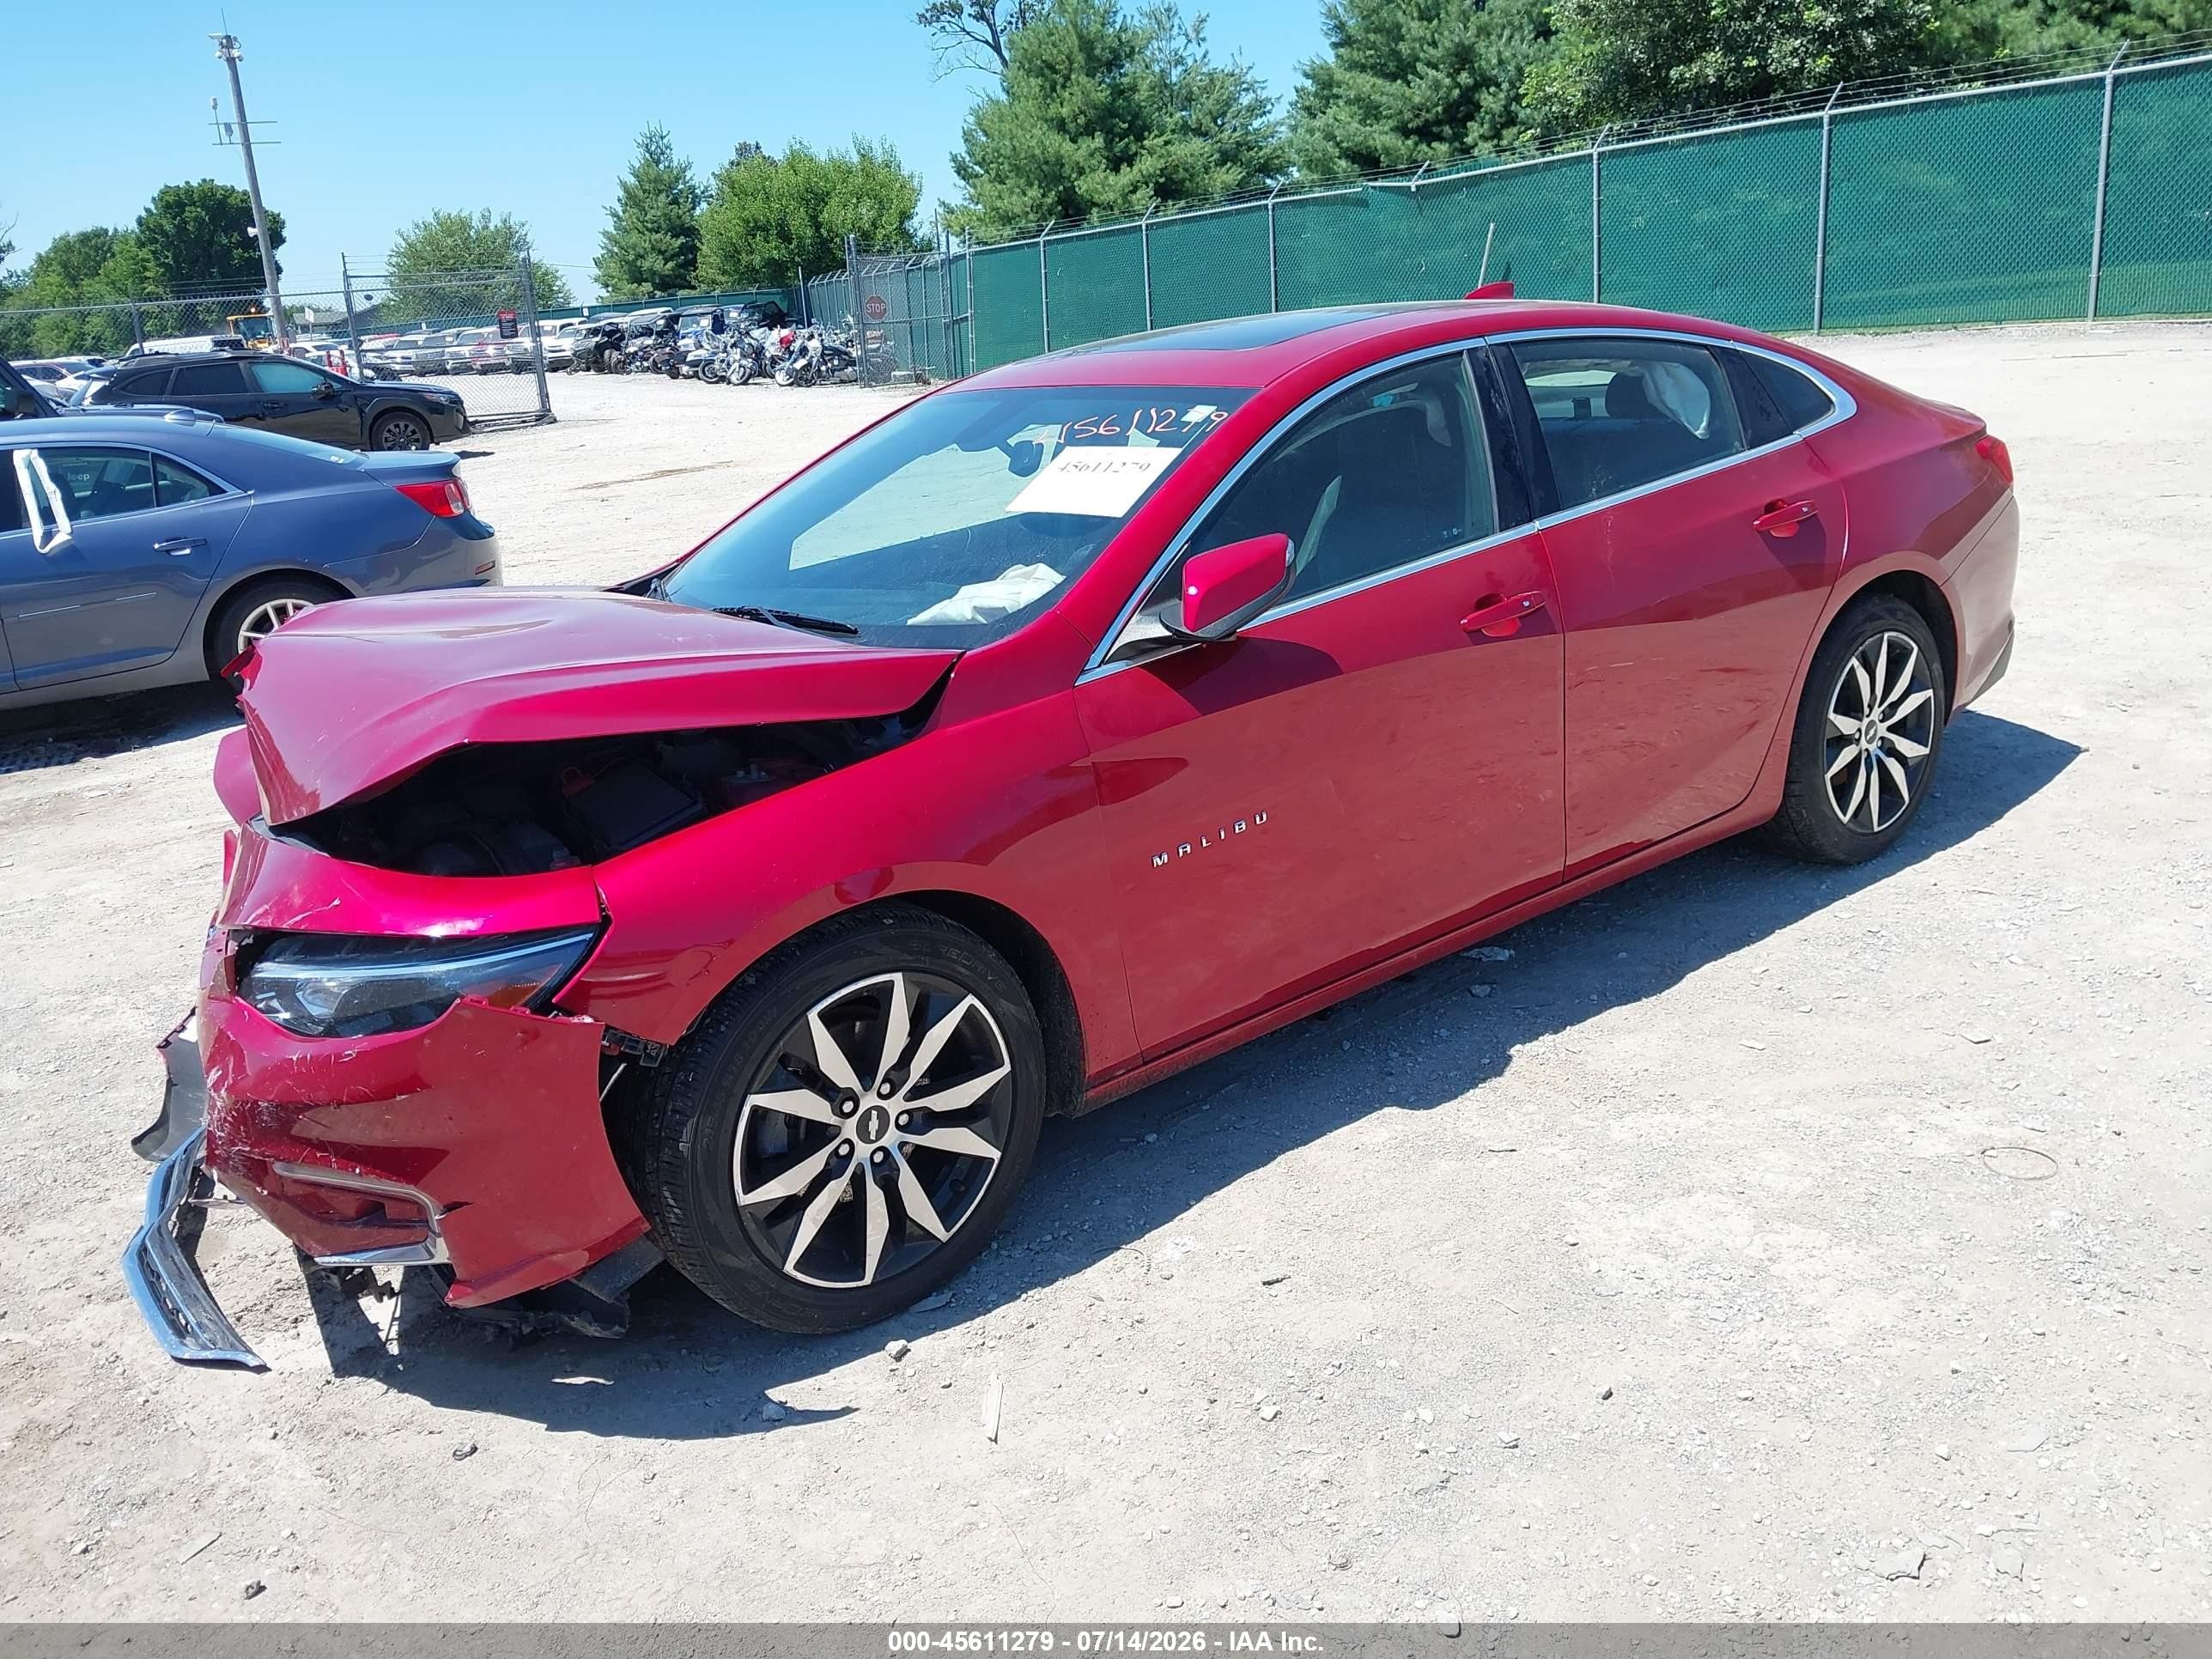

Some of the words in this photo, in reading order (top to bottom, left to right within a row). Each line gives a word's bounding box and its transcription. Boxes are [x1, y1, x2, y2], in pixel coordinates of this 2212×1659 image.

[866, 303, 886, 313] STOP
[1057, 460, 1151, 473] 45611279
[1152, 811, 1267, 868] MALIBU
